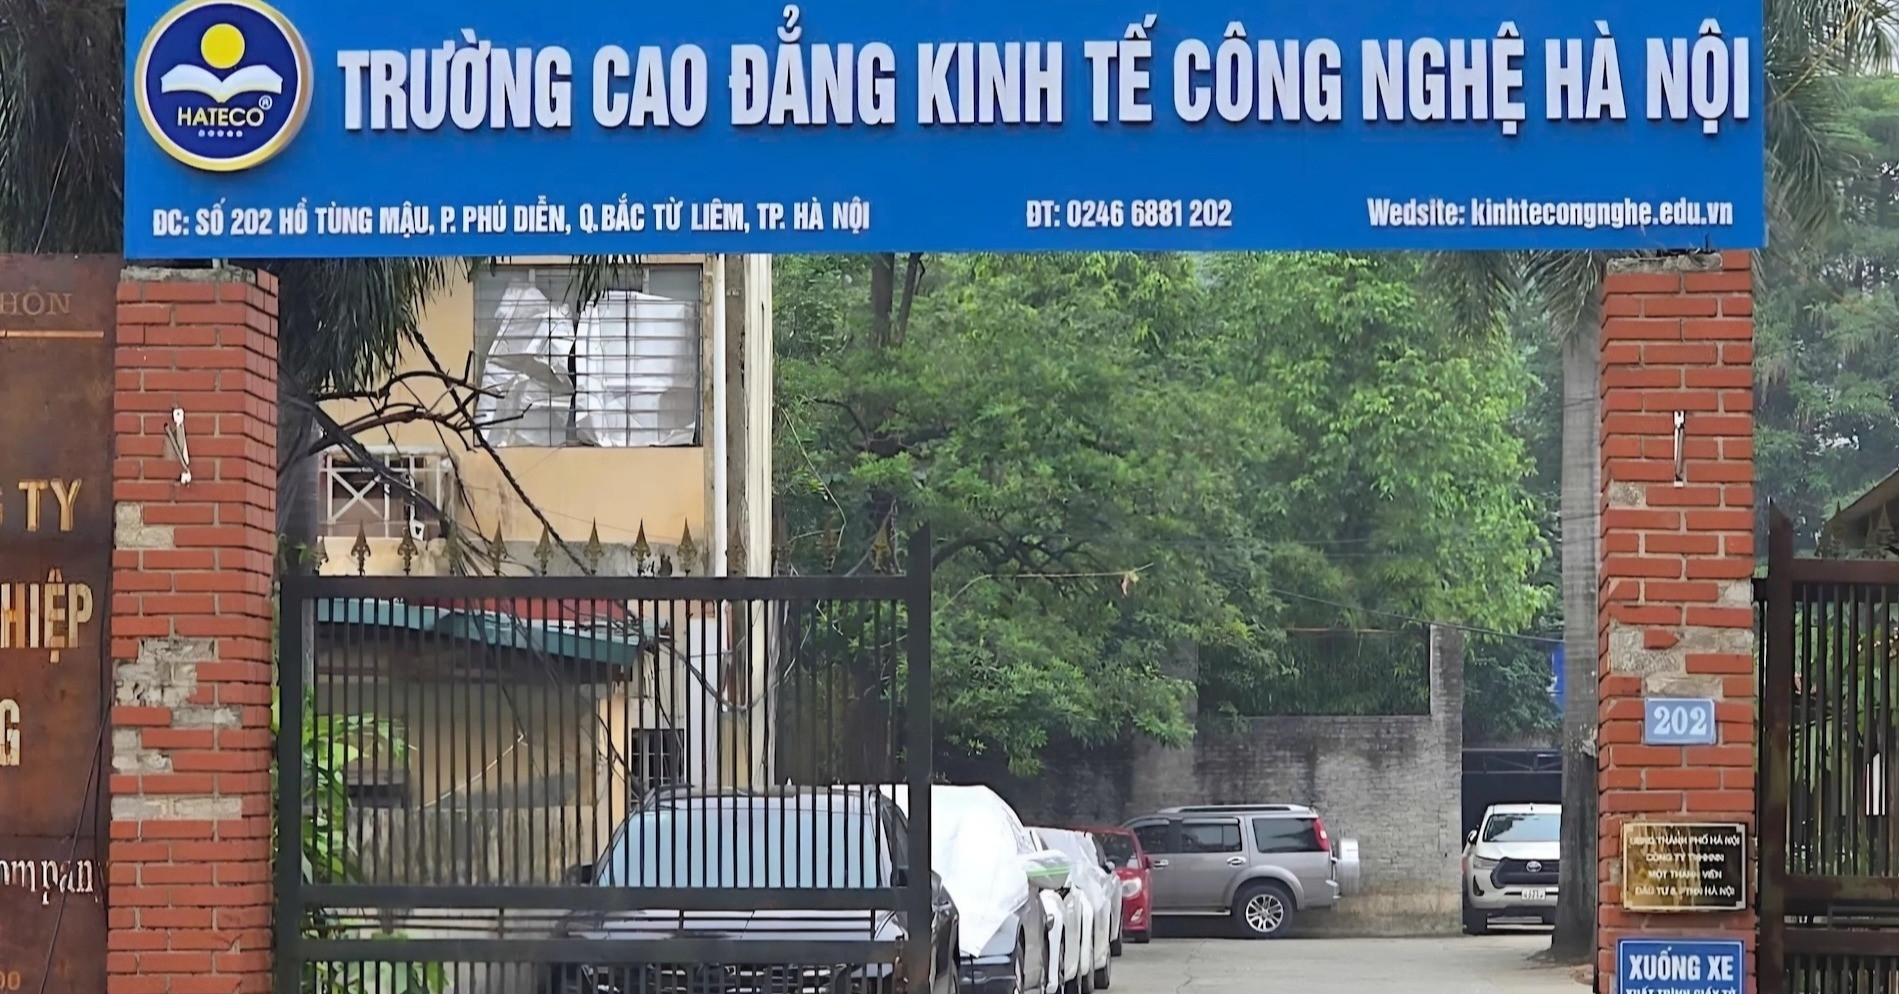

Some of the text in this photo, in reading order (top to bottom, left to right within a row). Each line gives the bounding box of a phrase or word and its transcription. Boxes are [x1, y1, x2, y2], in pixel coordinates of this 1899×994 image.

[338, 5, 1750, 135] TRƯỜNG CAO ĐẲNG KINH TẾ CÔNG NGHỆ HÀ NỘI
[177, 106, 265, 127] HATECO
[152, 208, 190, 236] ĐC:
[195, 198, 226, 236] SỐ
[230, 208, 273, 235] 202
[279, 197, 308, 235] HỒ
[314, 201, 373, 234] TÙNG
[379, 200, 435, 239] MẬU,
[440, 206, 456, 233] P.
[462, 199, 507, 233] PHÚ
[513, 195, 572, 235] DIỄN,
[652, 196, 685, 231] TỪ
[691, 198, 750, 234] LIÊM,
[756, 202, 786, 230] TP.
[793, 197, 824, 230] HÀ
[832, 196, 870, 235] NỘI
[1026, 199, 1232, 228] ĐT: 0246 6881 202
[1367, 197, 1733, 229] Wedsite: kinhtecongnghe.edu.vn
[18, 477, 83, 532] TY
[0, 567, 94, 663] HIỆP
[1653, 706, 1708, 735] 202
[1629, 946, 1734, 981] XUỐNG XE
